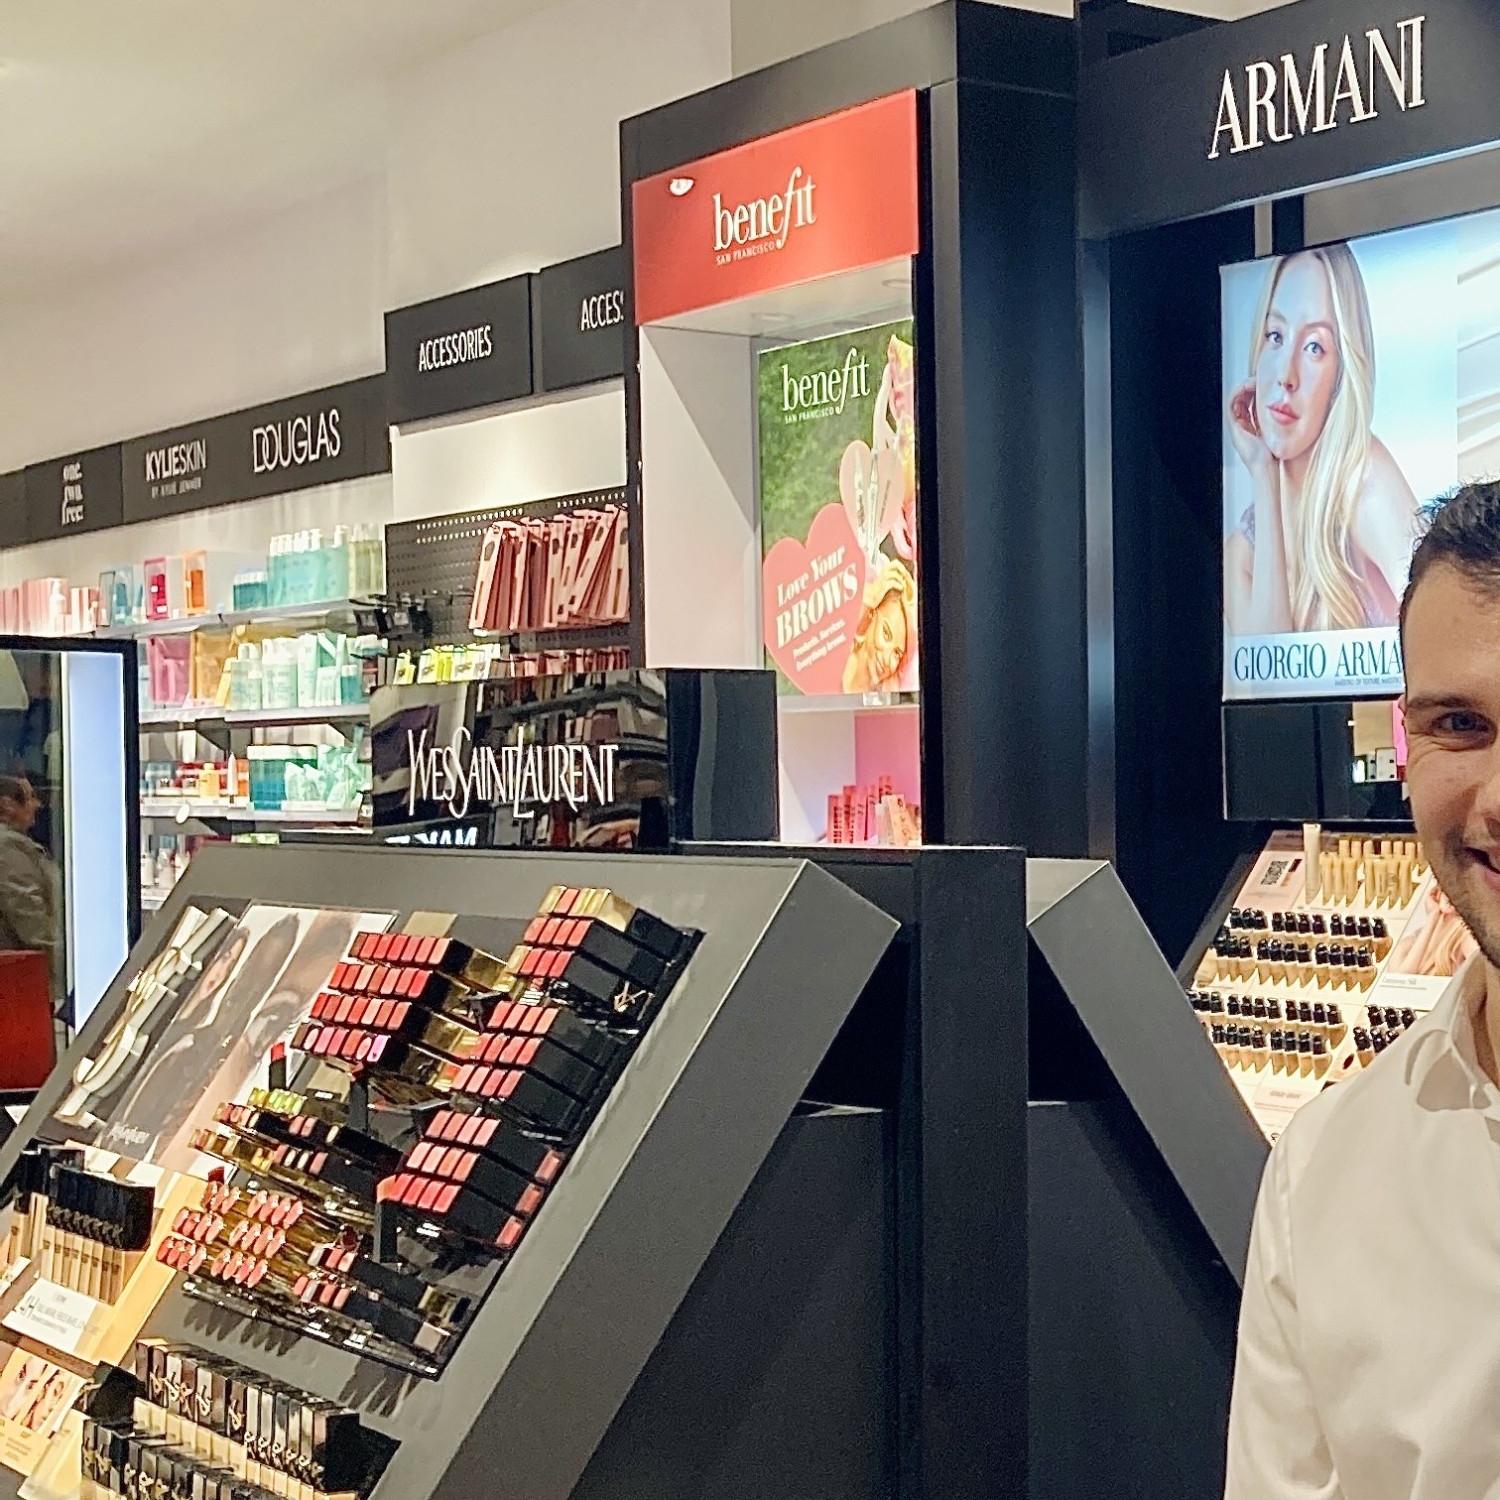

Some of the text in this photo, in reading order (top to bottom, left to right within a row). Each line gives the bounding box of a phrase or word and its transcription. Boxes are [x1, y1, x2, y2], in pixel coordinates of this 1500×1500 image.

[1208, 16, 1425, 159] ARMANI
[713, 166, 817, 250] benefit
[716, 241, 775, 265] SAN FRANCISCO
[419, 325, 492, 371] ACCESSORIES
[781, 347, 870, 414] benefit
[253, 409, 340, 473] DOUGLAS
[785, 406, 834, 424] SAN FRANCISCO
[776, 563, 858, 648] BROWS
[777, 546, 845, 607] Love Your
[1234, 643, 1326, 681] GIORGIO
